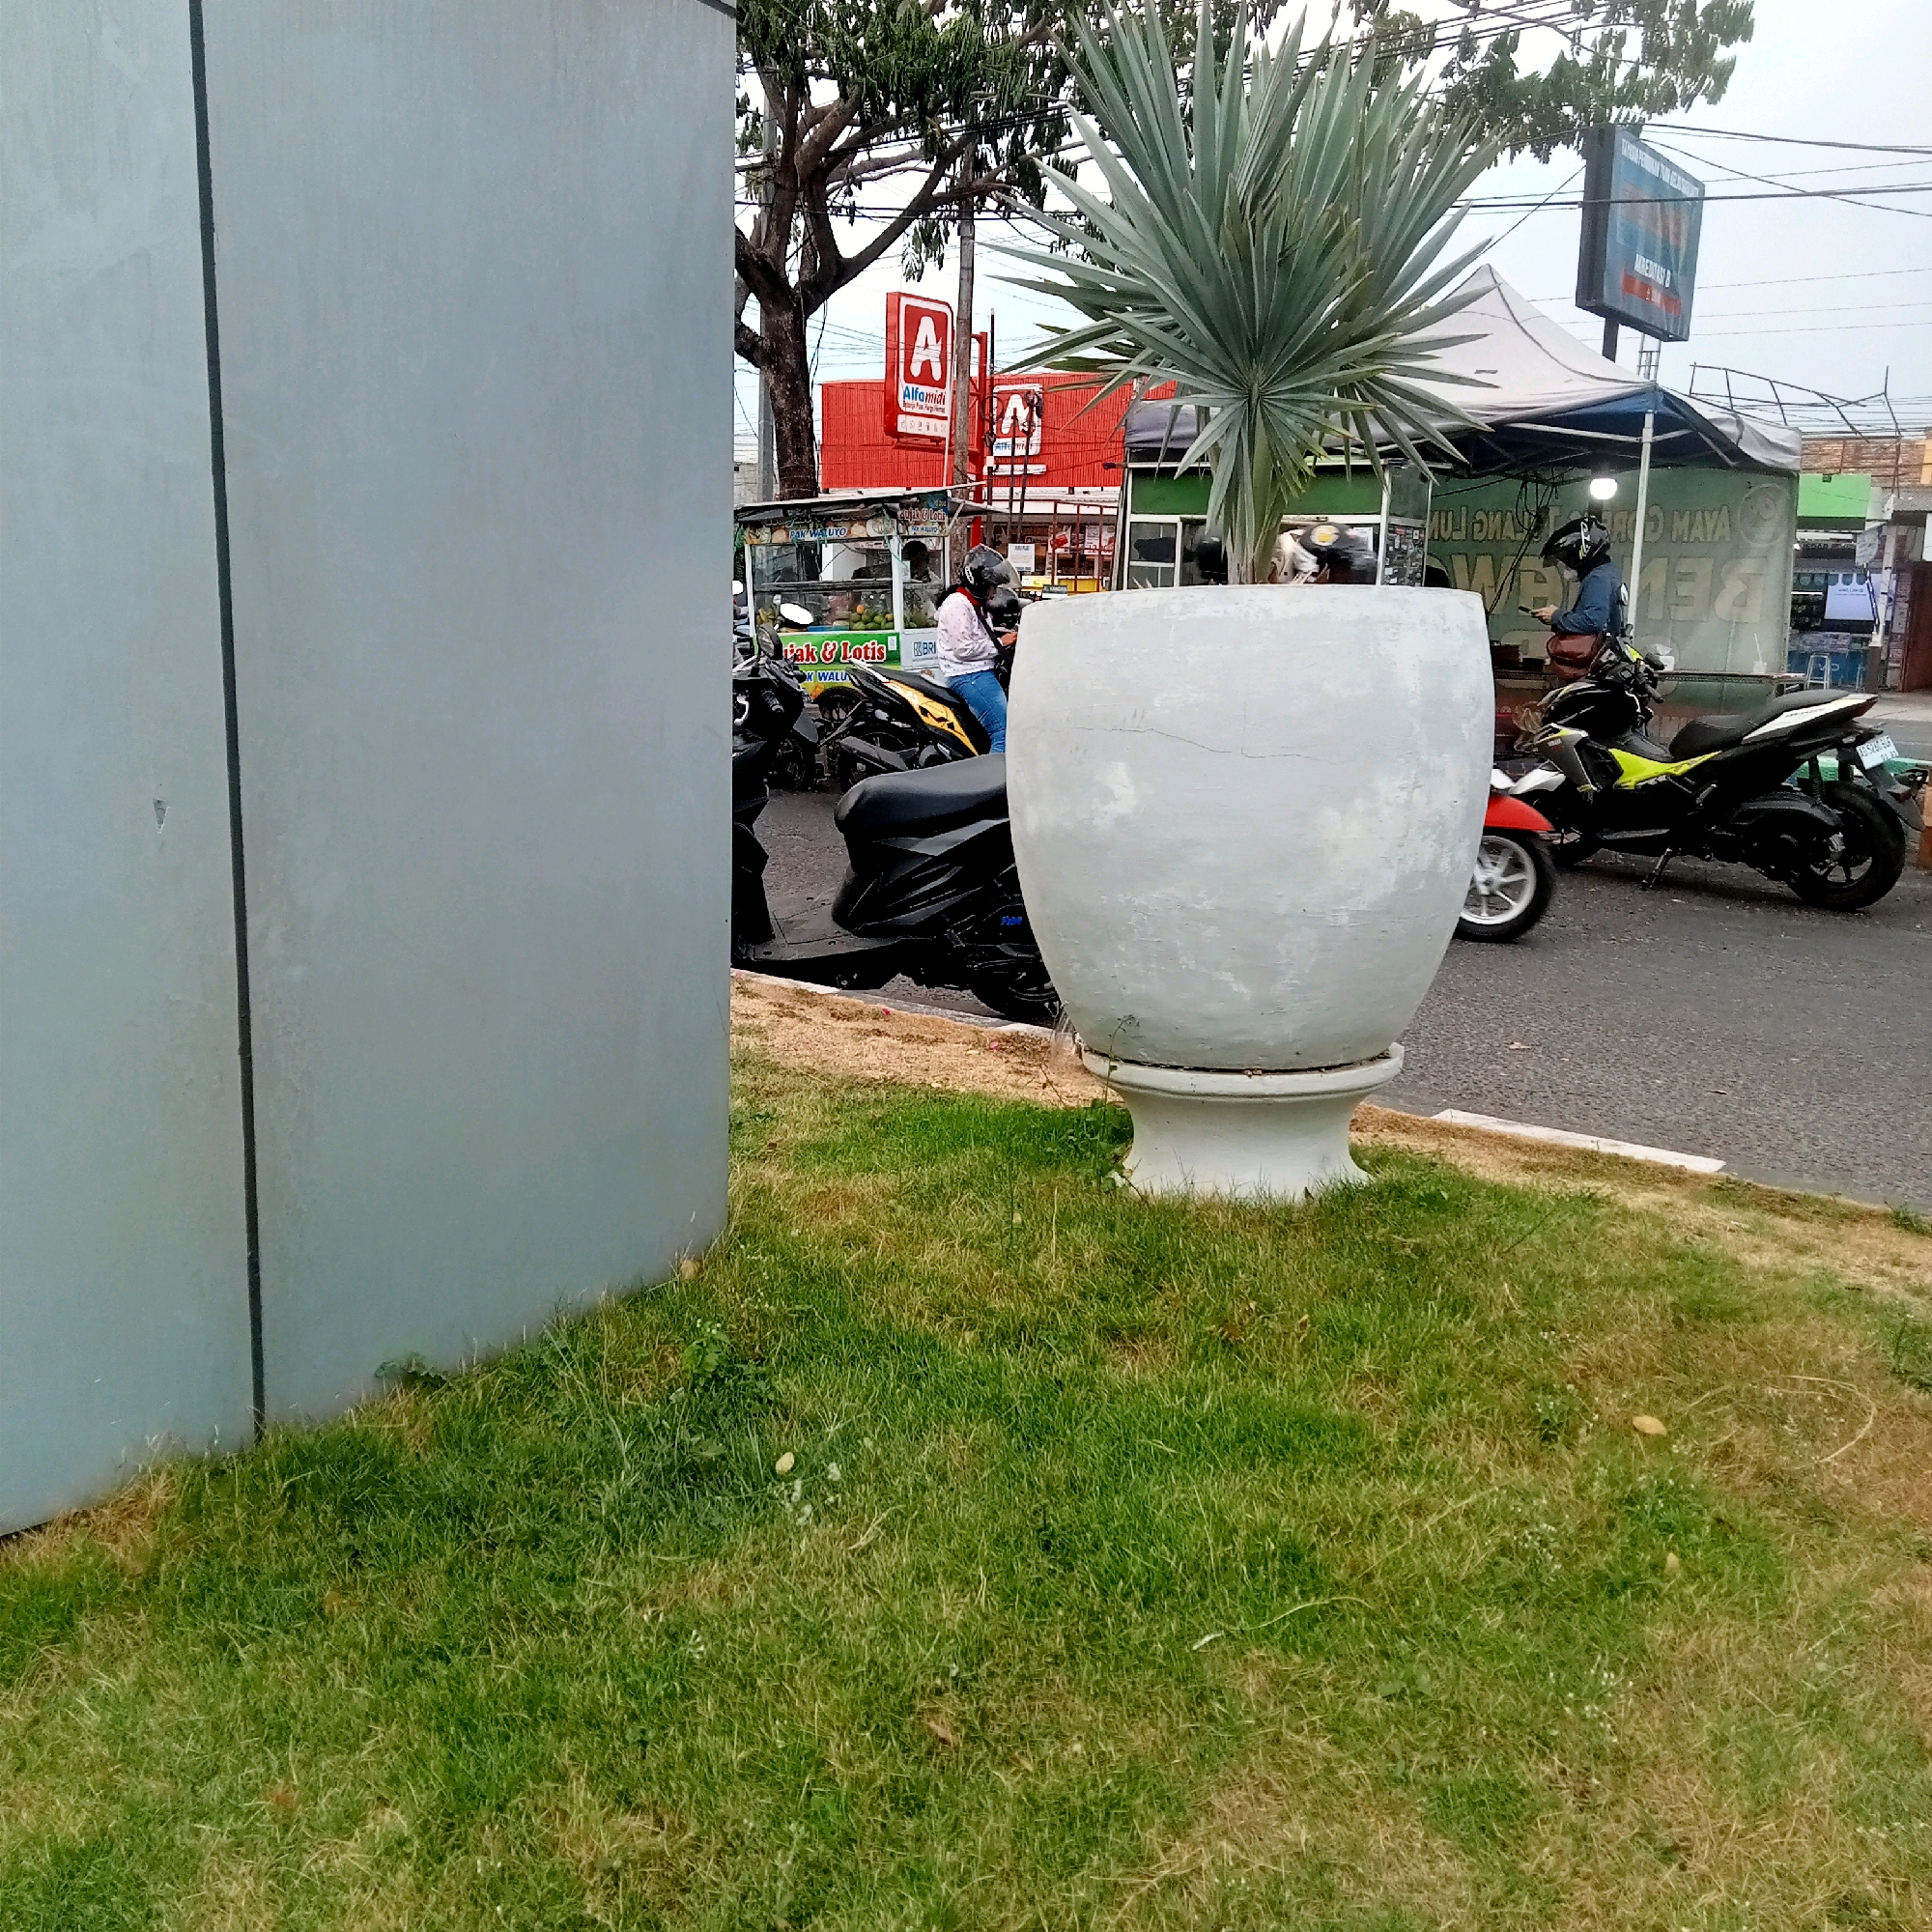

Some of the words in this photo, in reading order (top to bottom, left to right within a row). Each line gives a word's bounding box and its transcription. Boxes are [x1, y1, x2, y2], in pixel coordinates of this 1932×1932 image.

[910, 316, 942, 382] A
[902, 385, 946, 406] Alfamidi
[789, 529, 809, 540] PAK
[809, 526, 848, 539] WALUYO
[821, 641, 838, 665] &
[842, 640, 887, 664] Lotis
[922, 640, 937, 656] BRI
[817, 670, 851, 683] WALU
